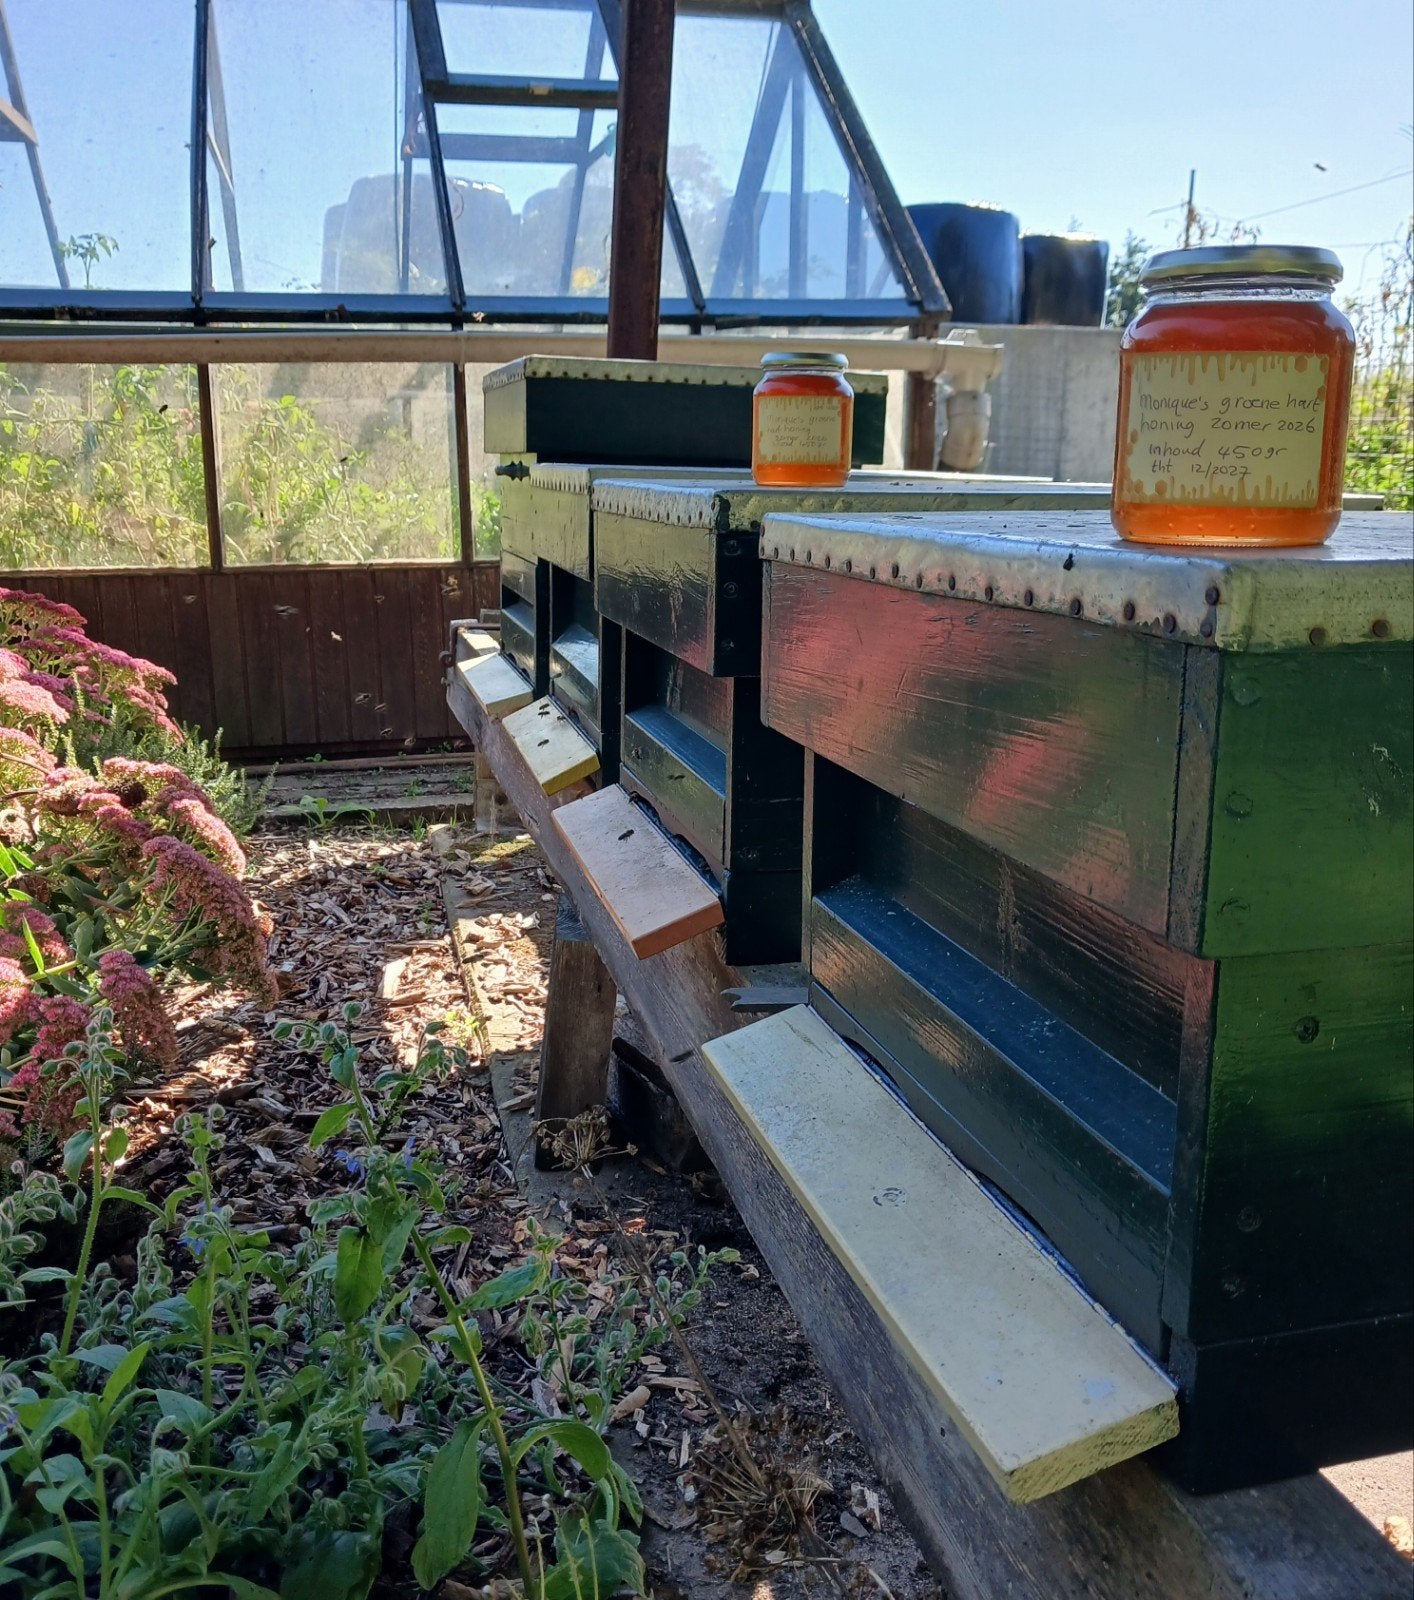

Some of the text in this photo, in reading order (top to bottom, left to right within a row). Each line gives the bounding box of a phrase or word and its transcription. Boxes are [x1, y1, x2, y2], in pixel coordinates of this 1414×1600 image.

[1140, 393, 1321, 416] Monique's groene hart
[1140, 413, 1194, 439] honing
[1277, 418, 1316, 433] 2026
[1152, 458, 1252, 480] tht 12/2027
